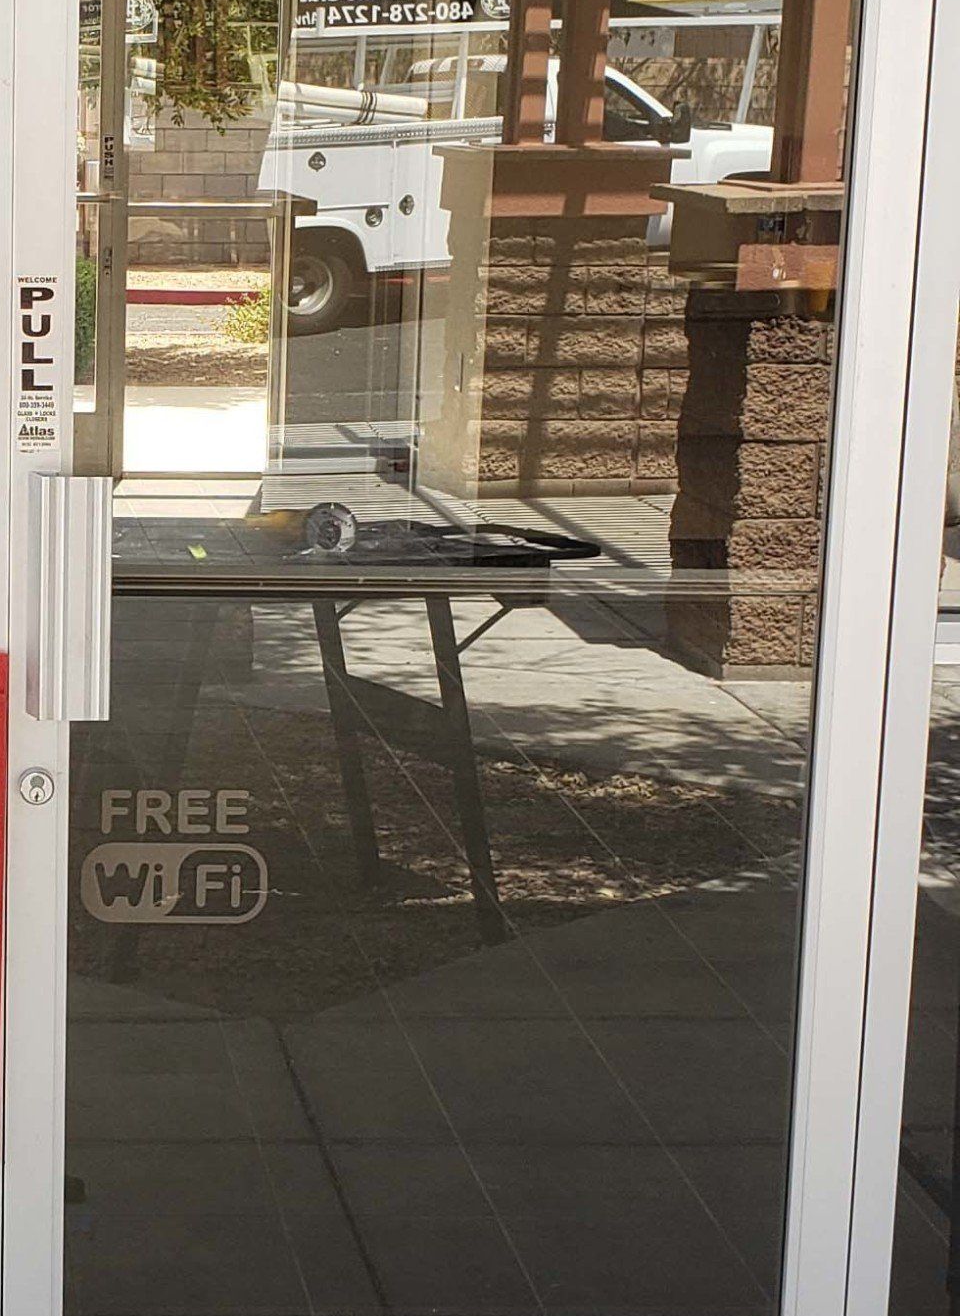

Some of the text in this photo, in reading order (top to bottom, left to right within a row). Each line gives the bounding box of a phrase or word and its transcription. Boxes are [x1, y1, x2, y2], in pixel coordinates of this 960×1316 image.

[104, 136, 114, 166] PUSH
[18, 276, 58, 284] WELCOME
[20, 287, 55, 391] PULL
[19, 424, 55, 436] Atlas
[101, 789, 250, 834] FREE
